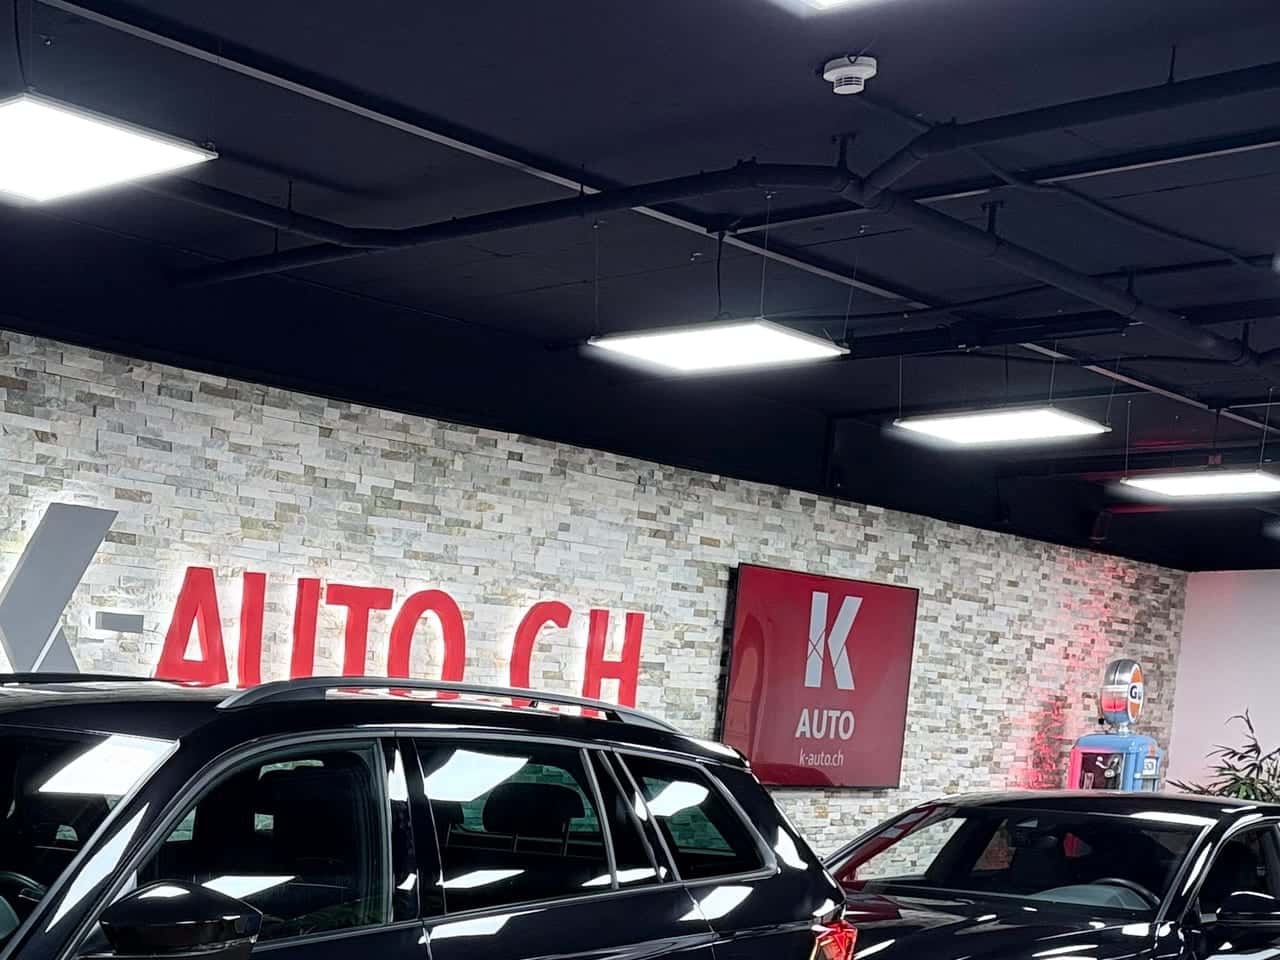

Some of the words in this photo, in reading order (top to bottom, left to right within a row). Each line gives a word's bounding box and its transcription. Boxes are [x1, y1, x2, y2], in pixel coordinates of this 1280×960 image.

[804, 591, 864, 690] K
[794, 707, 855, 740] AUTO
[799, 749, 844, 767] k-auto.ch
